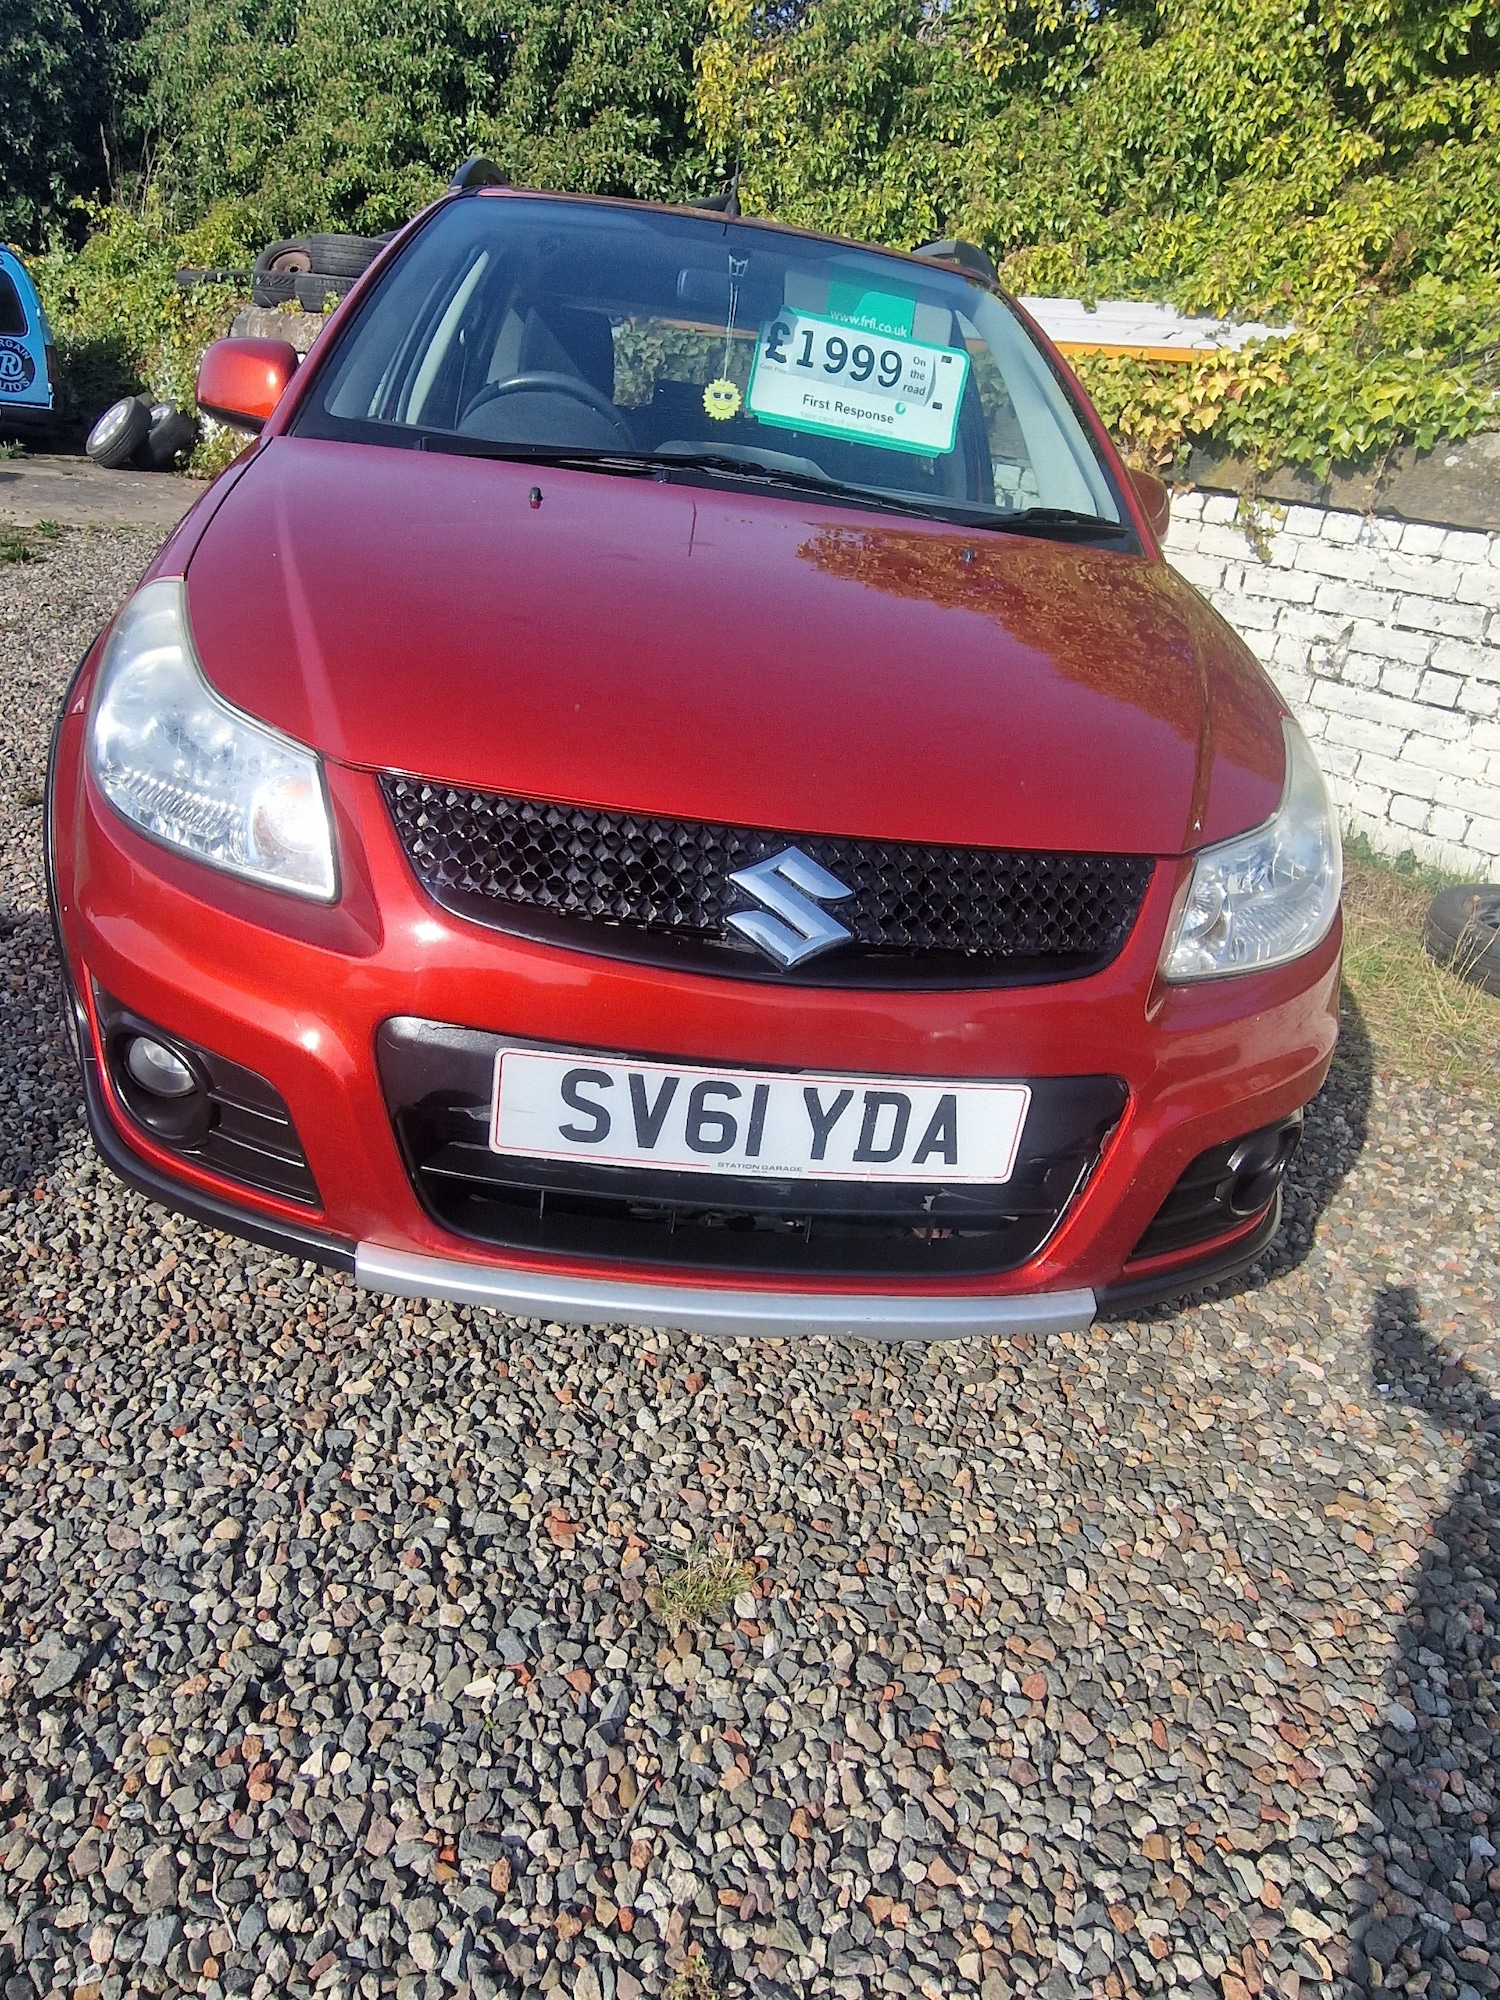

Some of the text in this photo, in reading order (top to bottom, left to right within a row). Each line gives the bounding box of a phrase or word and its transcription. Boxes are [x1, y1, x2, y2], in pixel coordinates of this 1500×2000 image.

[830, 311, 907, 338] www.frfl.co.uk
[765, 321, 902, 387] £1999
[913, 356, 926, 367] On
[910, 369, 925, 380] the
[903, 384, 926, 395] road
[802, 394, 894, 423] First Response
[558, 1068, 959, 1165] SV61 YDA
[717, 1162, 759, 1170] STATION
[762, 1165, 803, 1173] GARAGE
